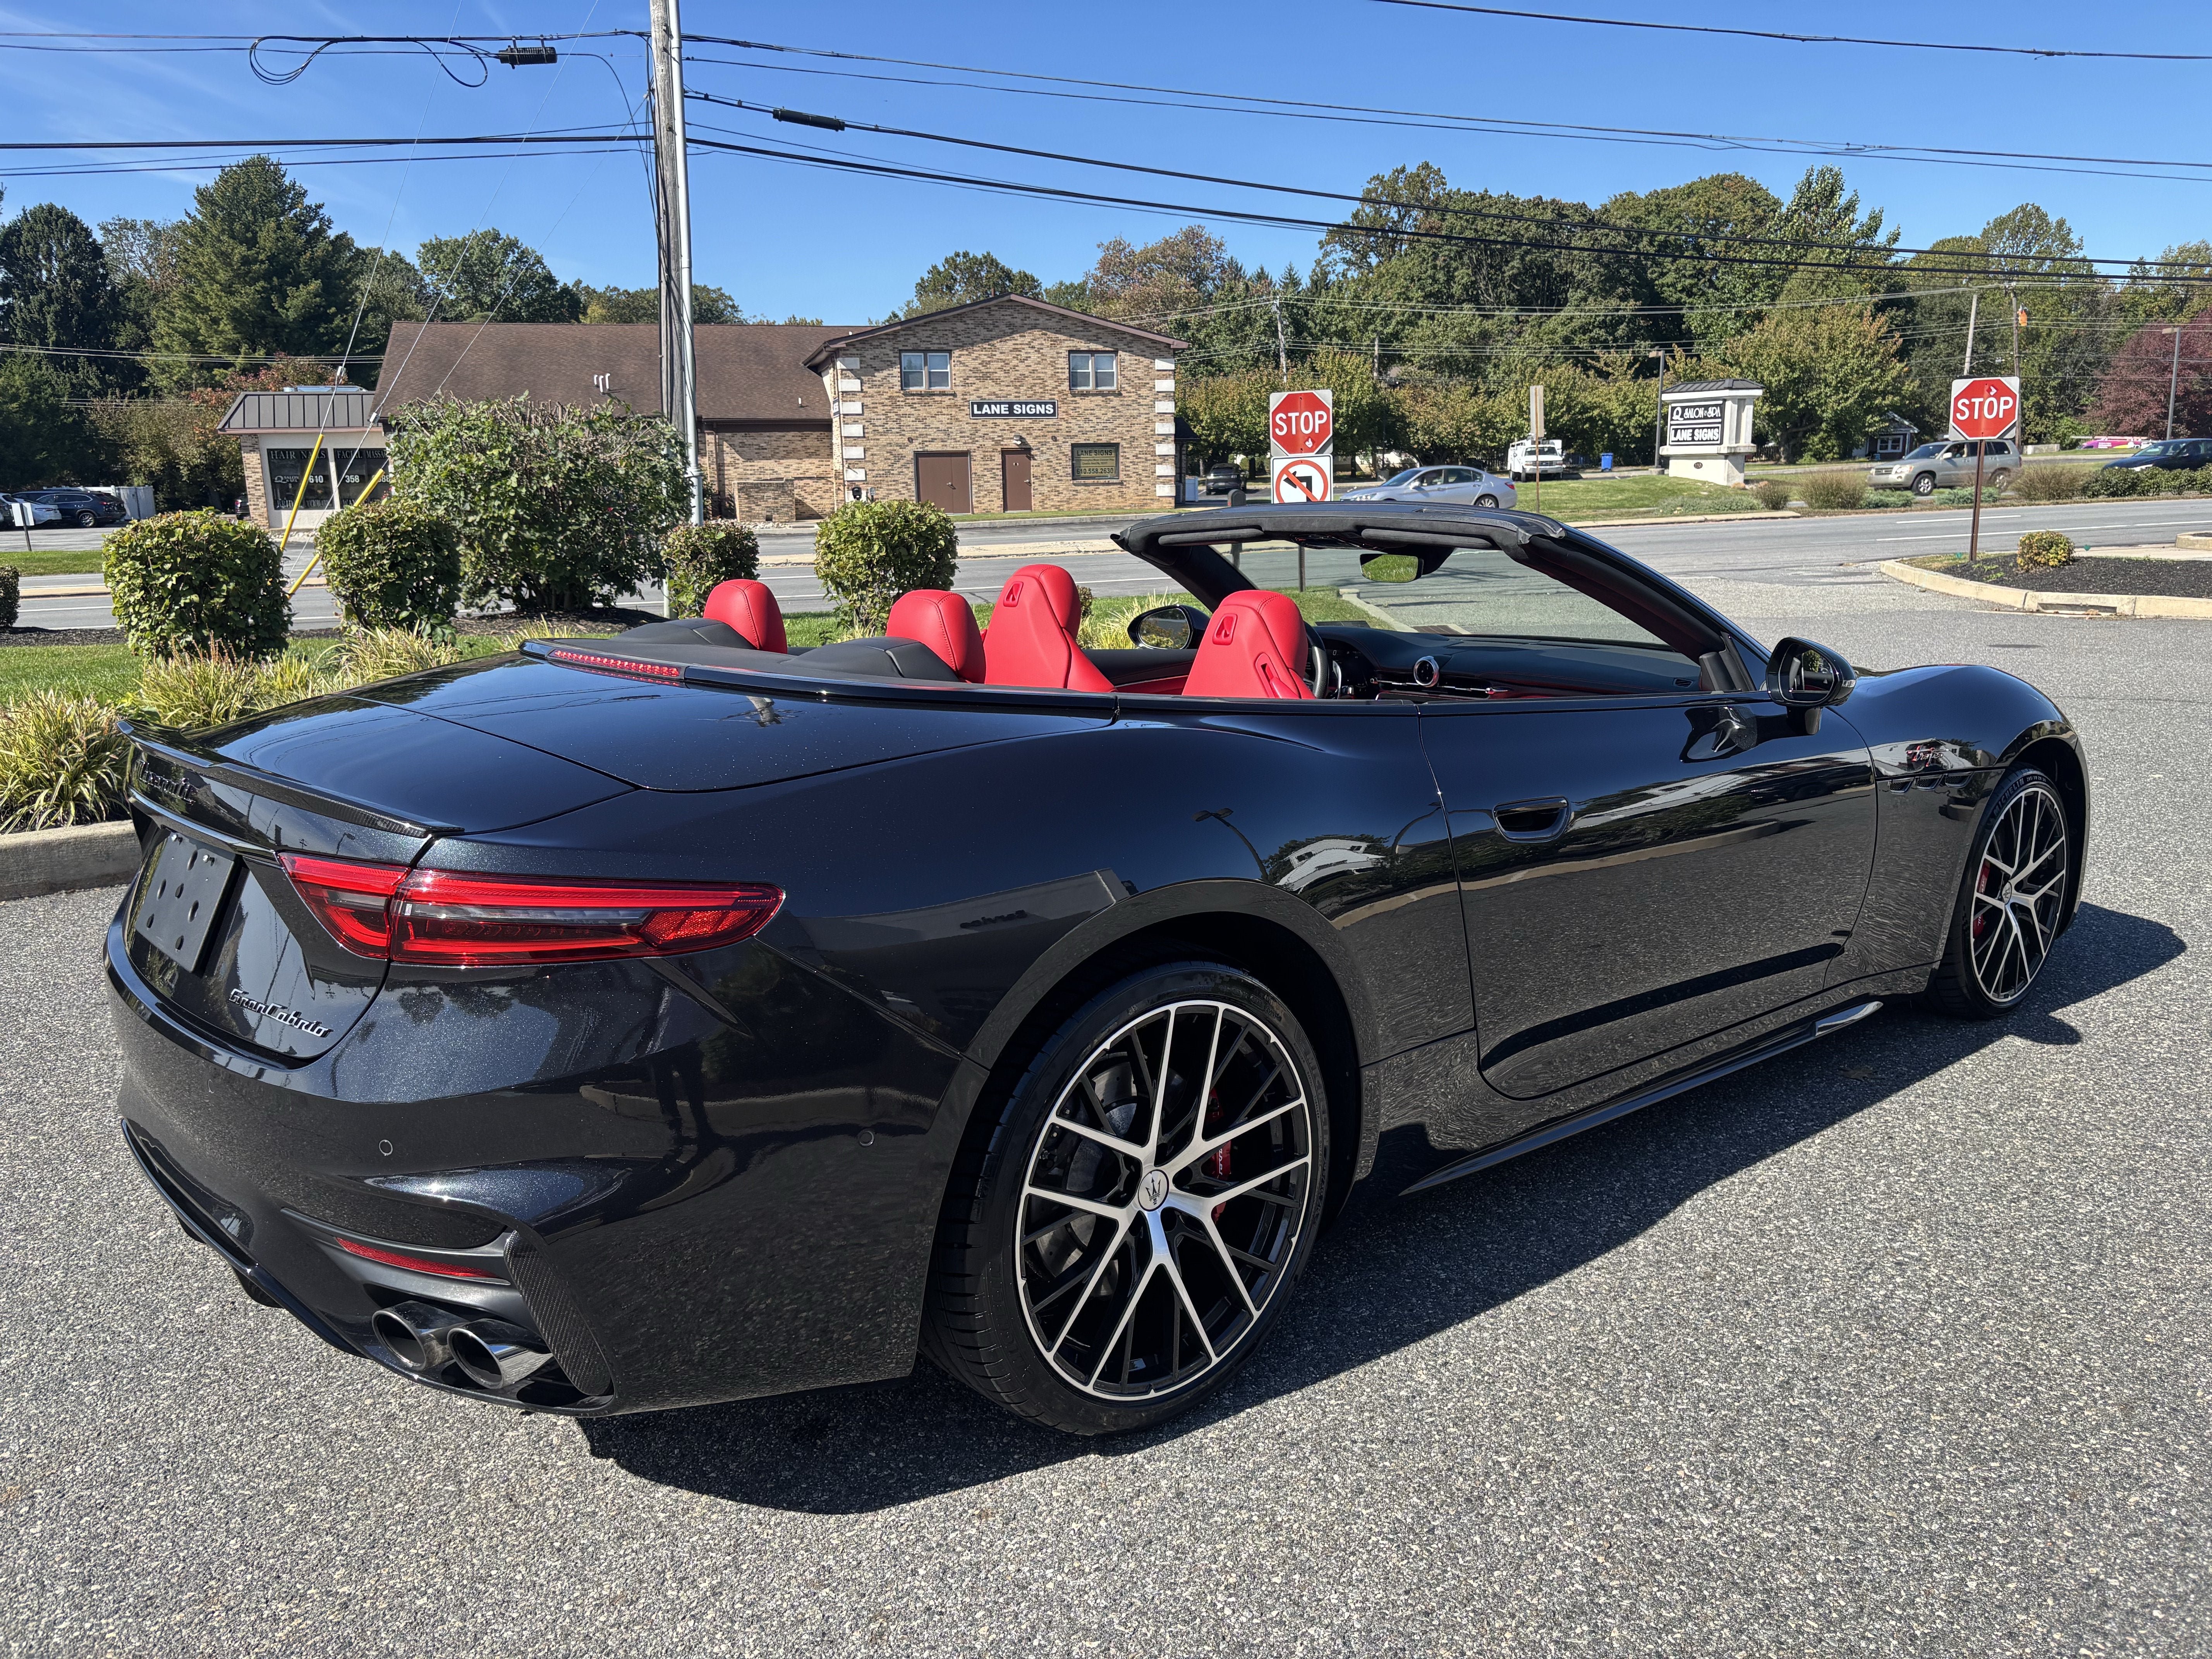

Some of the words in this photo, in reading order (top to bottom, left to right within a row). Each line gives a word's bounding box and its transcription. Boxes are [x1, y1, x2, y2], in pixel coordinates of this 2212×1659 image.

[973, 404, 1009, 414] LANE
[1013, 404, 1054, 414] SIGNS
[1672, 407, 1684, 421] Q
[1683, 408, 1704, 419] SALON
[1707, 406, 1721, 417] SPA
[1956, 397, 2013, 420] STOP
[1275, 410, 1327, 436] STOP
[1671, 429, 1693, 441] LANE
[1693, 428, 1719, 441] SIGNS
[271, 451, 296, 459] HAIR
[1994, 778, 2025, 816] MICHELIN
[228, 988, 329, 1037] GranCabrio
[1306, 1053, 1329, 1146] MICHELIN
